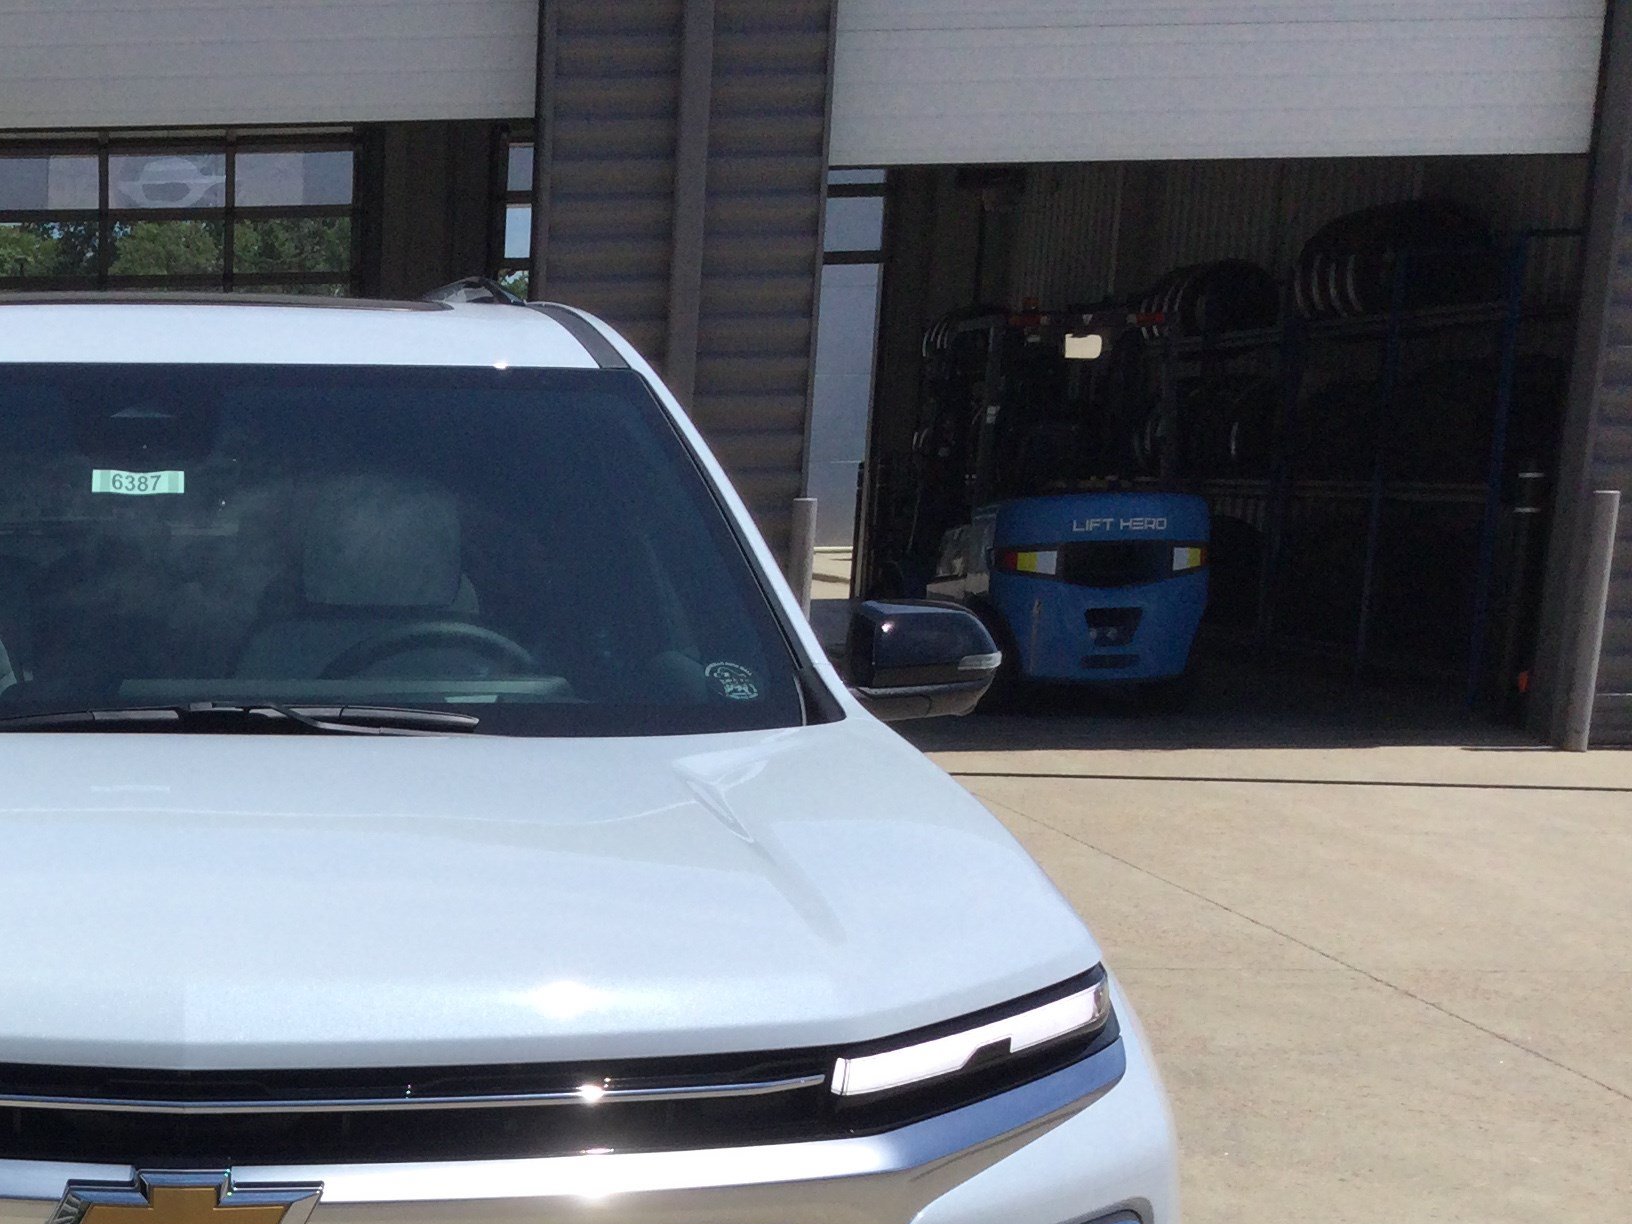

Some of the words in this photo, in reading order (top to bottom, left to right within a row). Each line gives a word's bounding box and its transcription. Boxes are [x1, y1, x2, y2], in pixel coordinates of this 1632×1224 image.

[111, 473, 162, 492] 6387
[1072, 518, 1114, 532] LIFT
[1119, 517, 1168, 531] HERO
